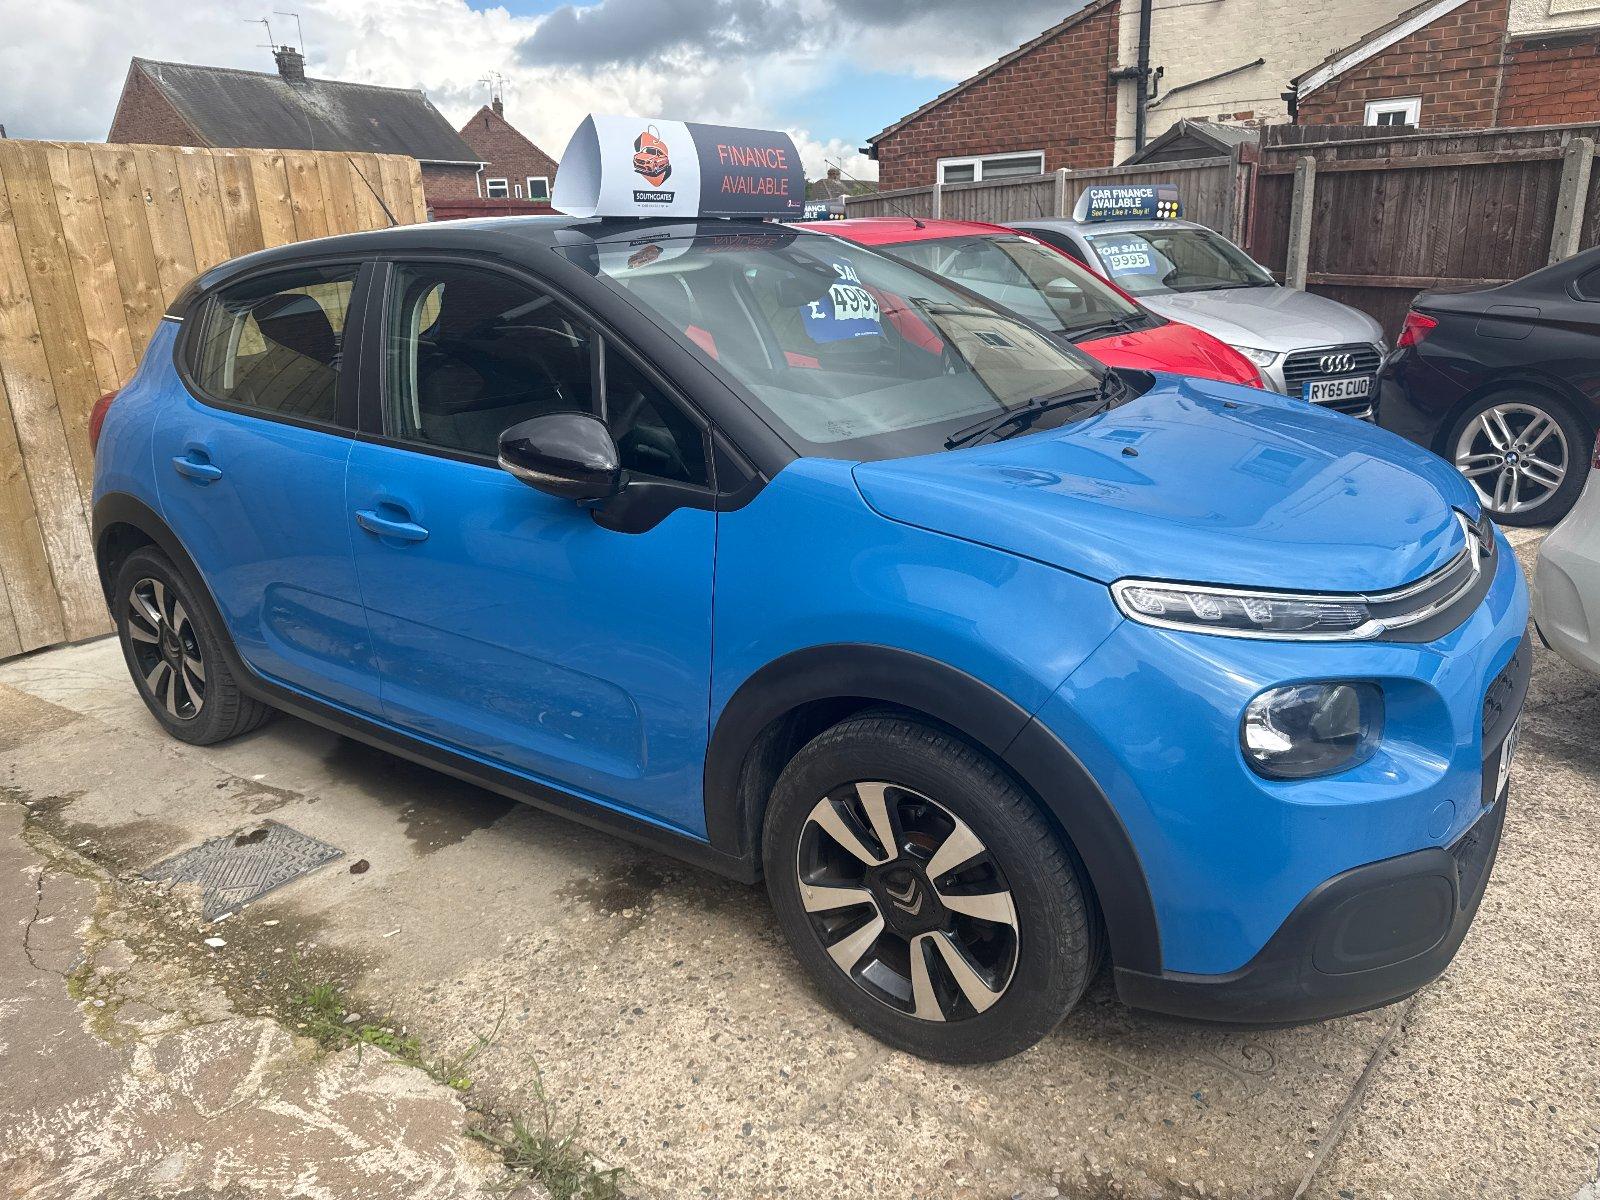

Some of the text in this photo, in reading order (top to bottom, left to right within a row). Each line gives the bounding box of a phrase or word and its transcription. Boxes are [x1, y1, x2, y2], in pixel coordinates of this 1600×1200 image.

[717, 144, 788, 170] FINANCE
[721, 175, 789, 196] AVAILABLE
[636, 192, 672, 201] SOUTHCOATES
[1091, 189, 1153, 199] CAR FINANCE
[1092, 198, 1141, 208] AVAILABLE
[1112, 208, 1123, 216] Like
[1133, 208, 1143, 216] Buy
[1122, 243, 1148, 253] SALE
[1112, 254, 1145, 267] 9995
[1311, 379, 1368, 400] RY65 CUO
